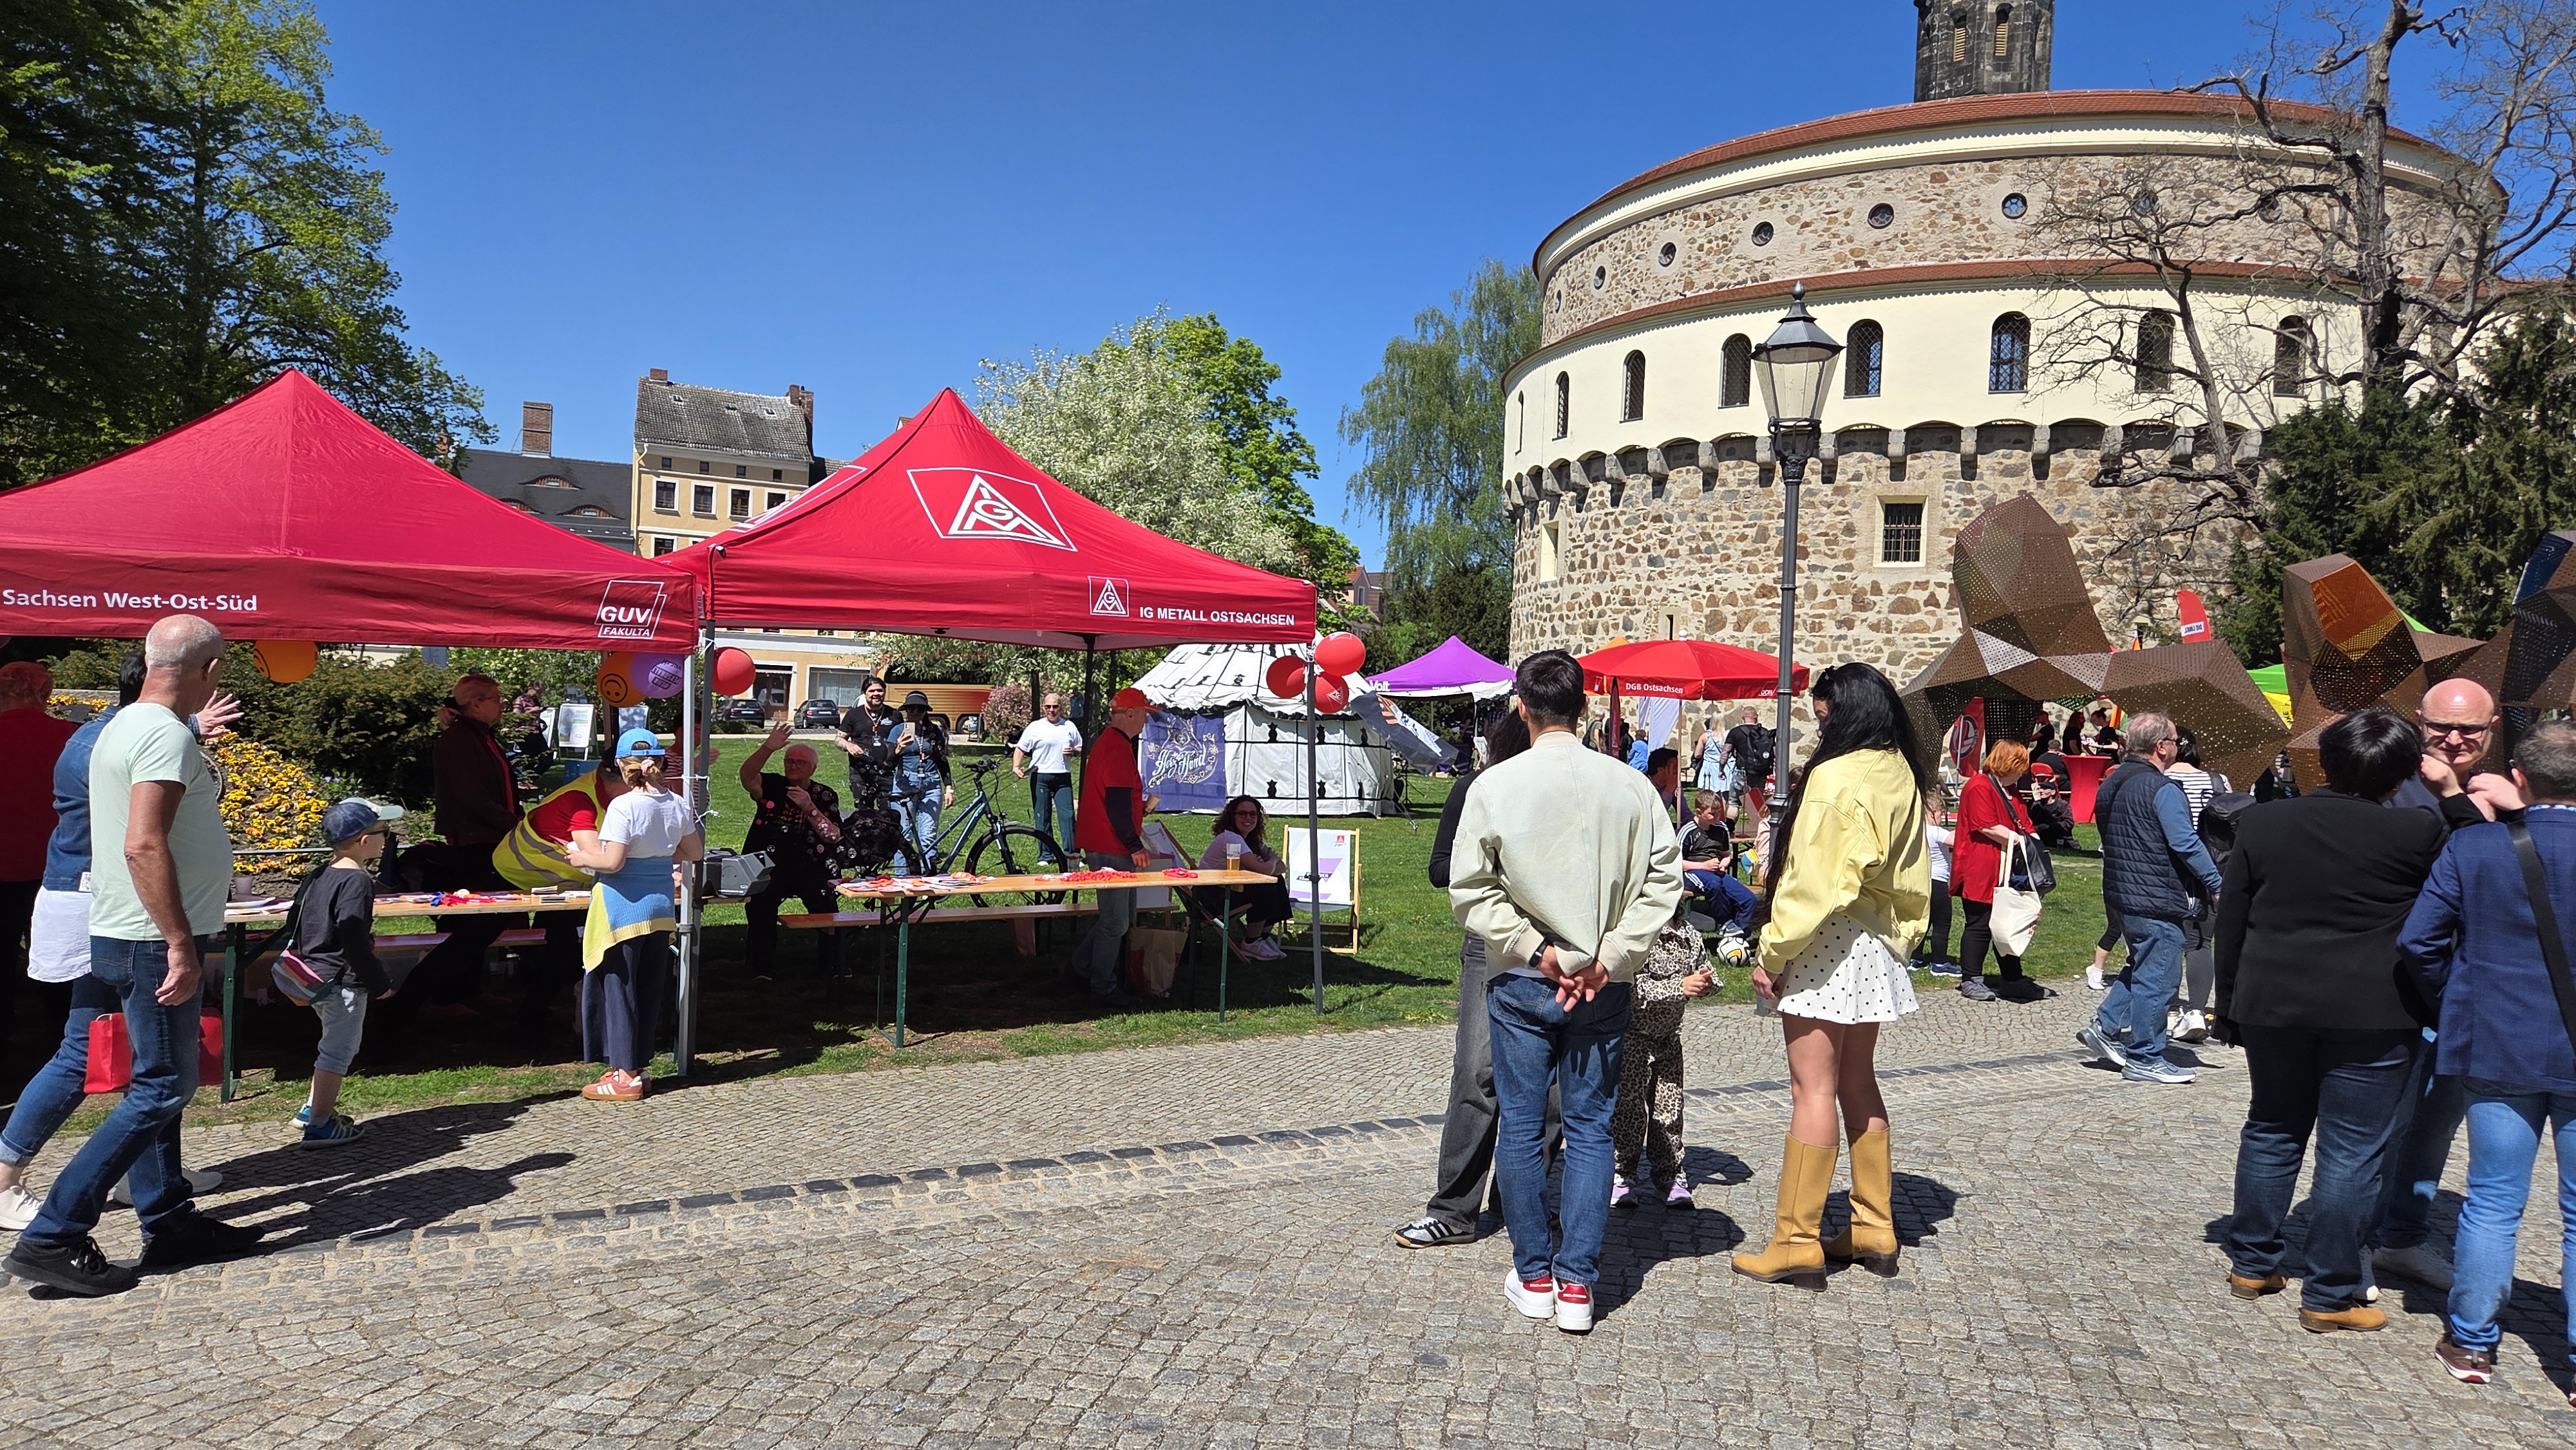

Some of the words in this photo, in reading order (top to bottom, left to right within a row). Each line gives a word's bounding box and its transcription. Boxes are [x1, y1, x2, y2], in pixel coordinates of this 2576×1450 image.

[3, 589, 97, 608] Sachsen
[104, 591, 258, 611] West-Ost-Süd
[600, 606, 651, 624] GUV
[1139, 607, 1154, 618] IG
[1157, 607, 1208, 621] METALL
[1210, 610, 1295, 626] OSTSACHSEN
[603, 626, 650, 637] FAKULTA
[1368, 679, 1390, 692] Volt
[1625, 683, 1642, 691] DGB
[1643, 683, 1683, 695] Ostsachsen
[1178, 744, 1207, 779] Hand
